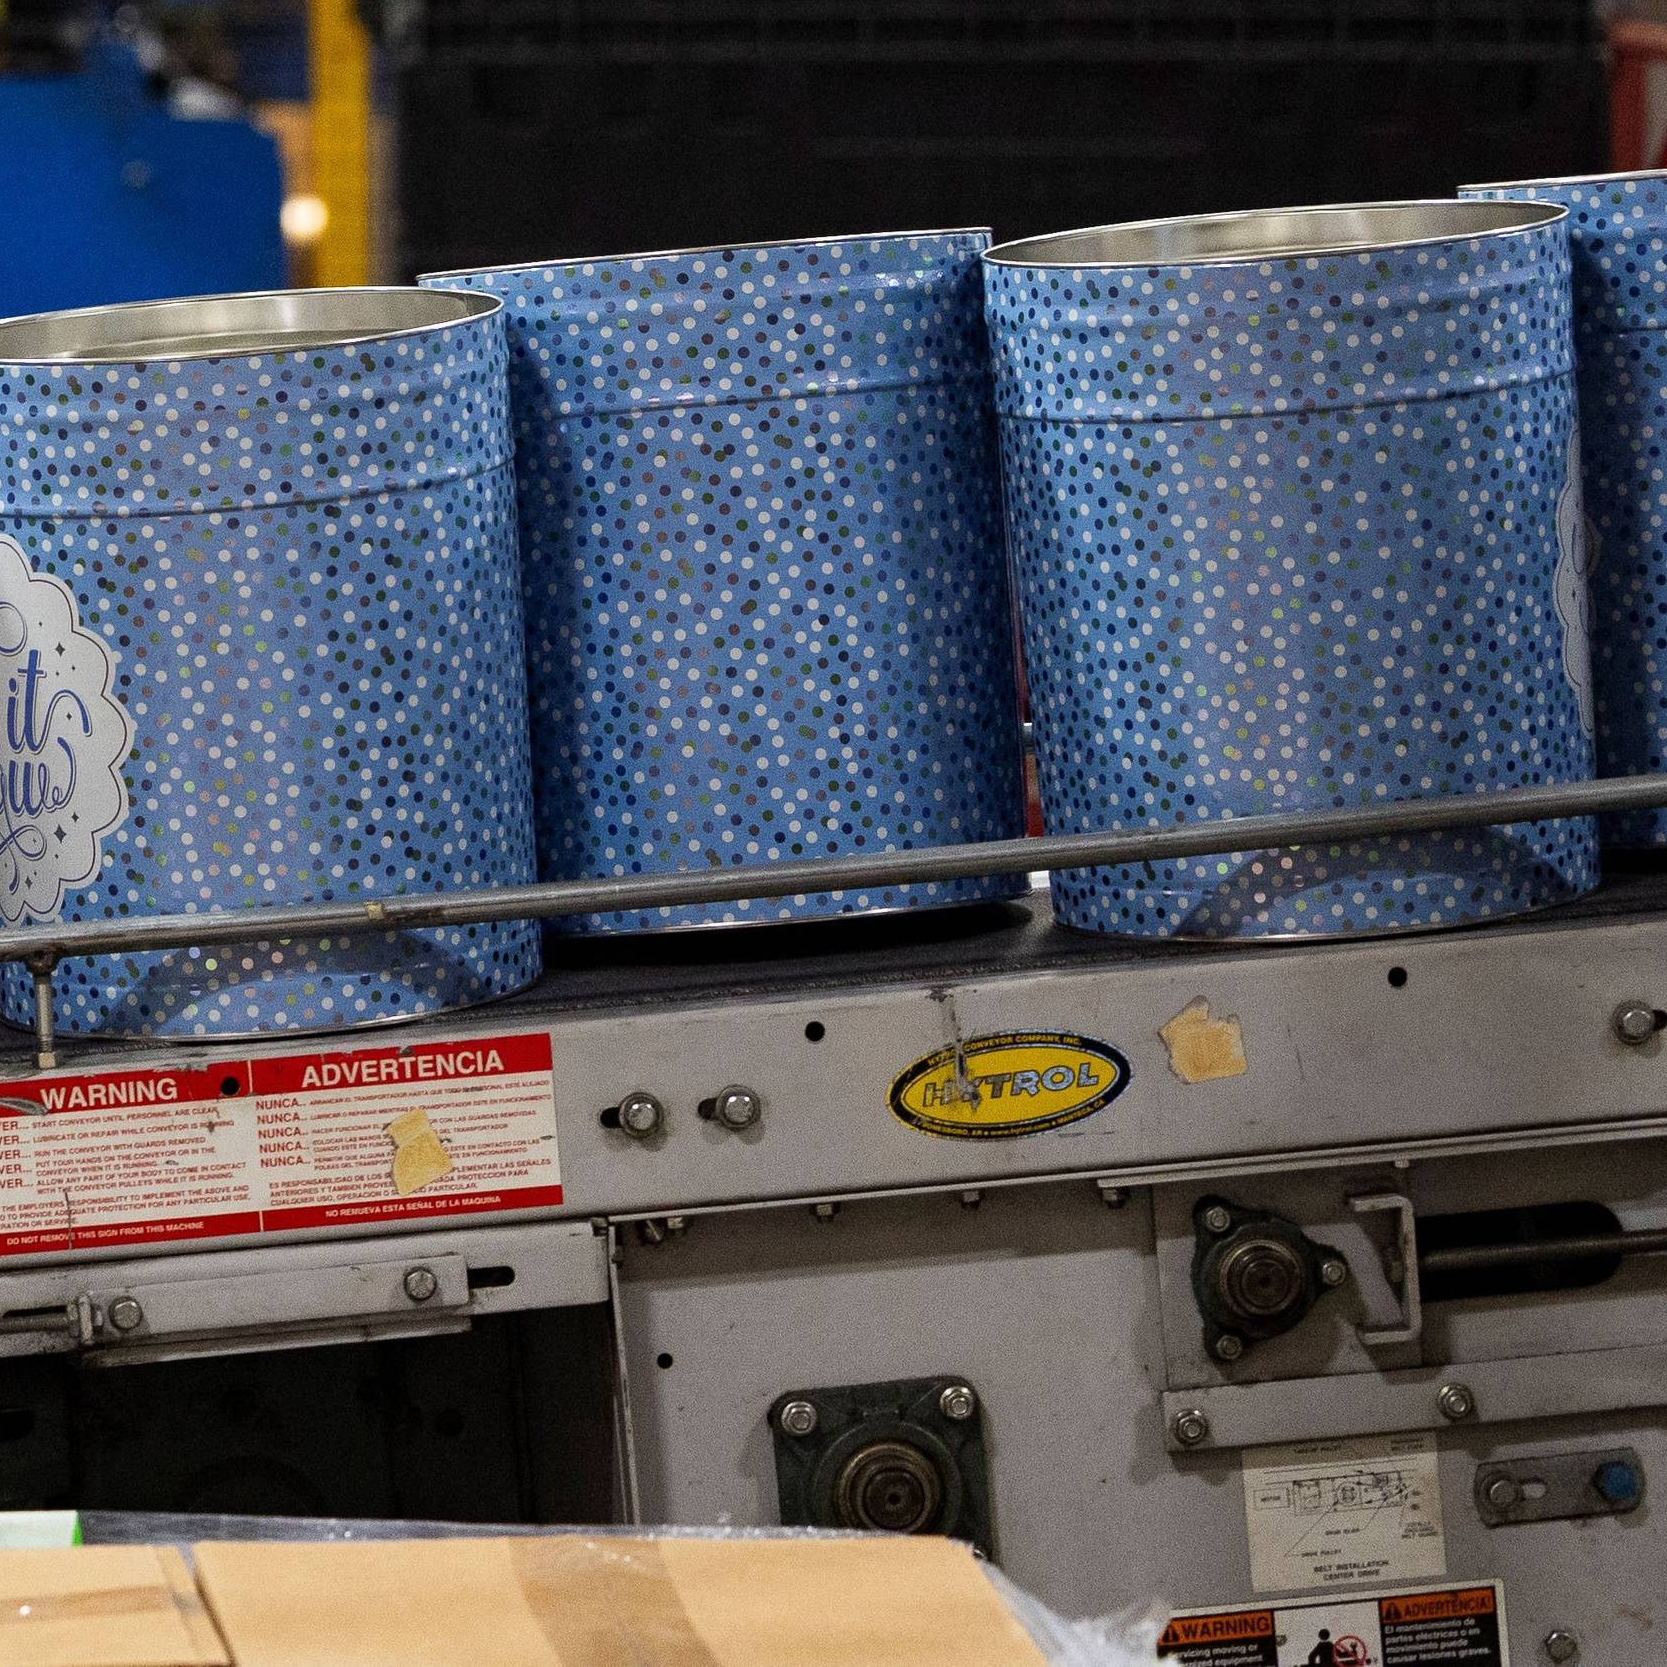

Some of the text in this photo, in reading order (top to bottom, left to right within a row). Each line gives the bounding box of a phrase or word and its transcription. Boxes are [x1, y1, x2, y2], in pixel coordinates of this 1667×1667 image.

[7, 649, 92, 754] it
[299, 1047, 504, 1088] ADVERTENCIA
[39, 1076, 178, 1110] WARNING
[7, 1237, 19, 1245] DO
[20, 1235, 38, 1244] NOT
[76, 1230, 96, 1239] THIS
[97, 1228, 118, 1238] SIGN
[119, 1226, 144, 1236] FROM
[145, 1224, 164, 1234] THIS
[165, 1221, 205, 1232] MACHINE
[1181, 1616, 1271, 1640] WARNING
[1211, 1644, 1258, 1657] moving or
